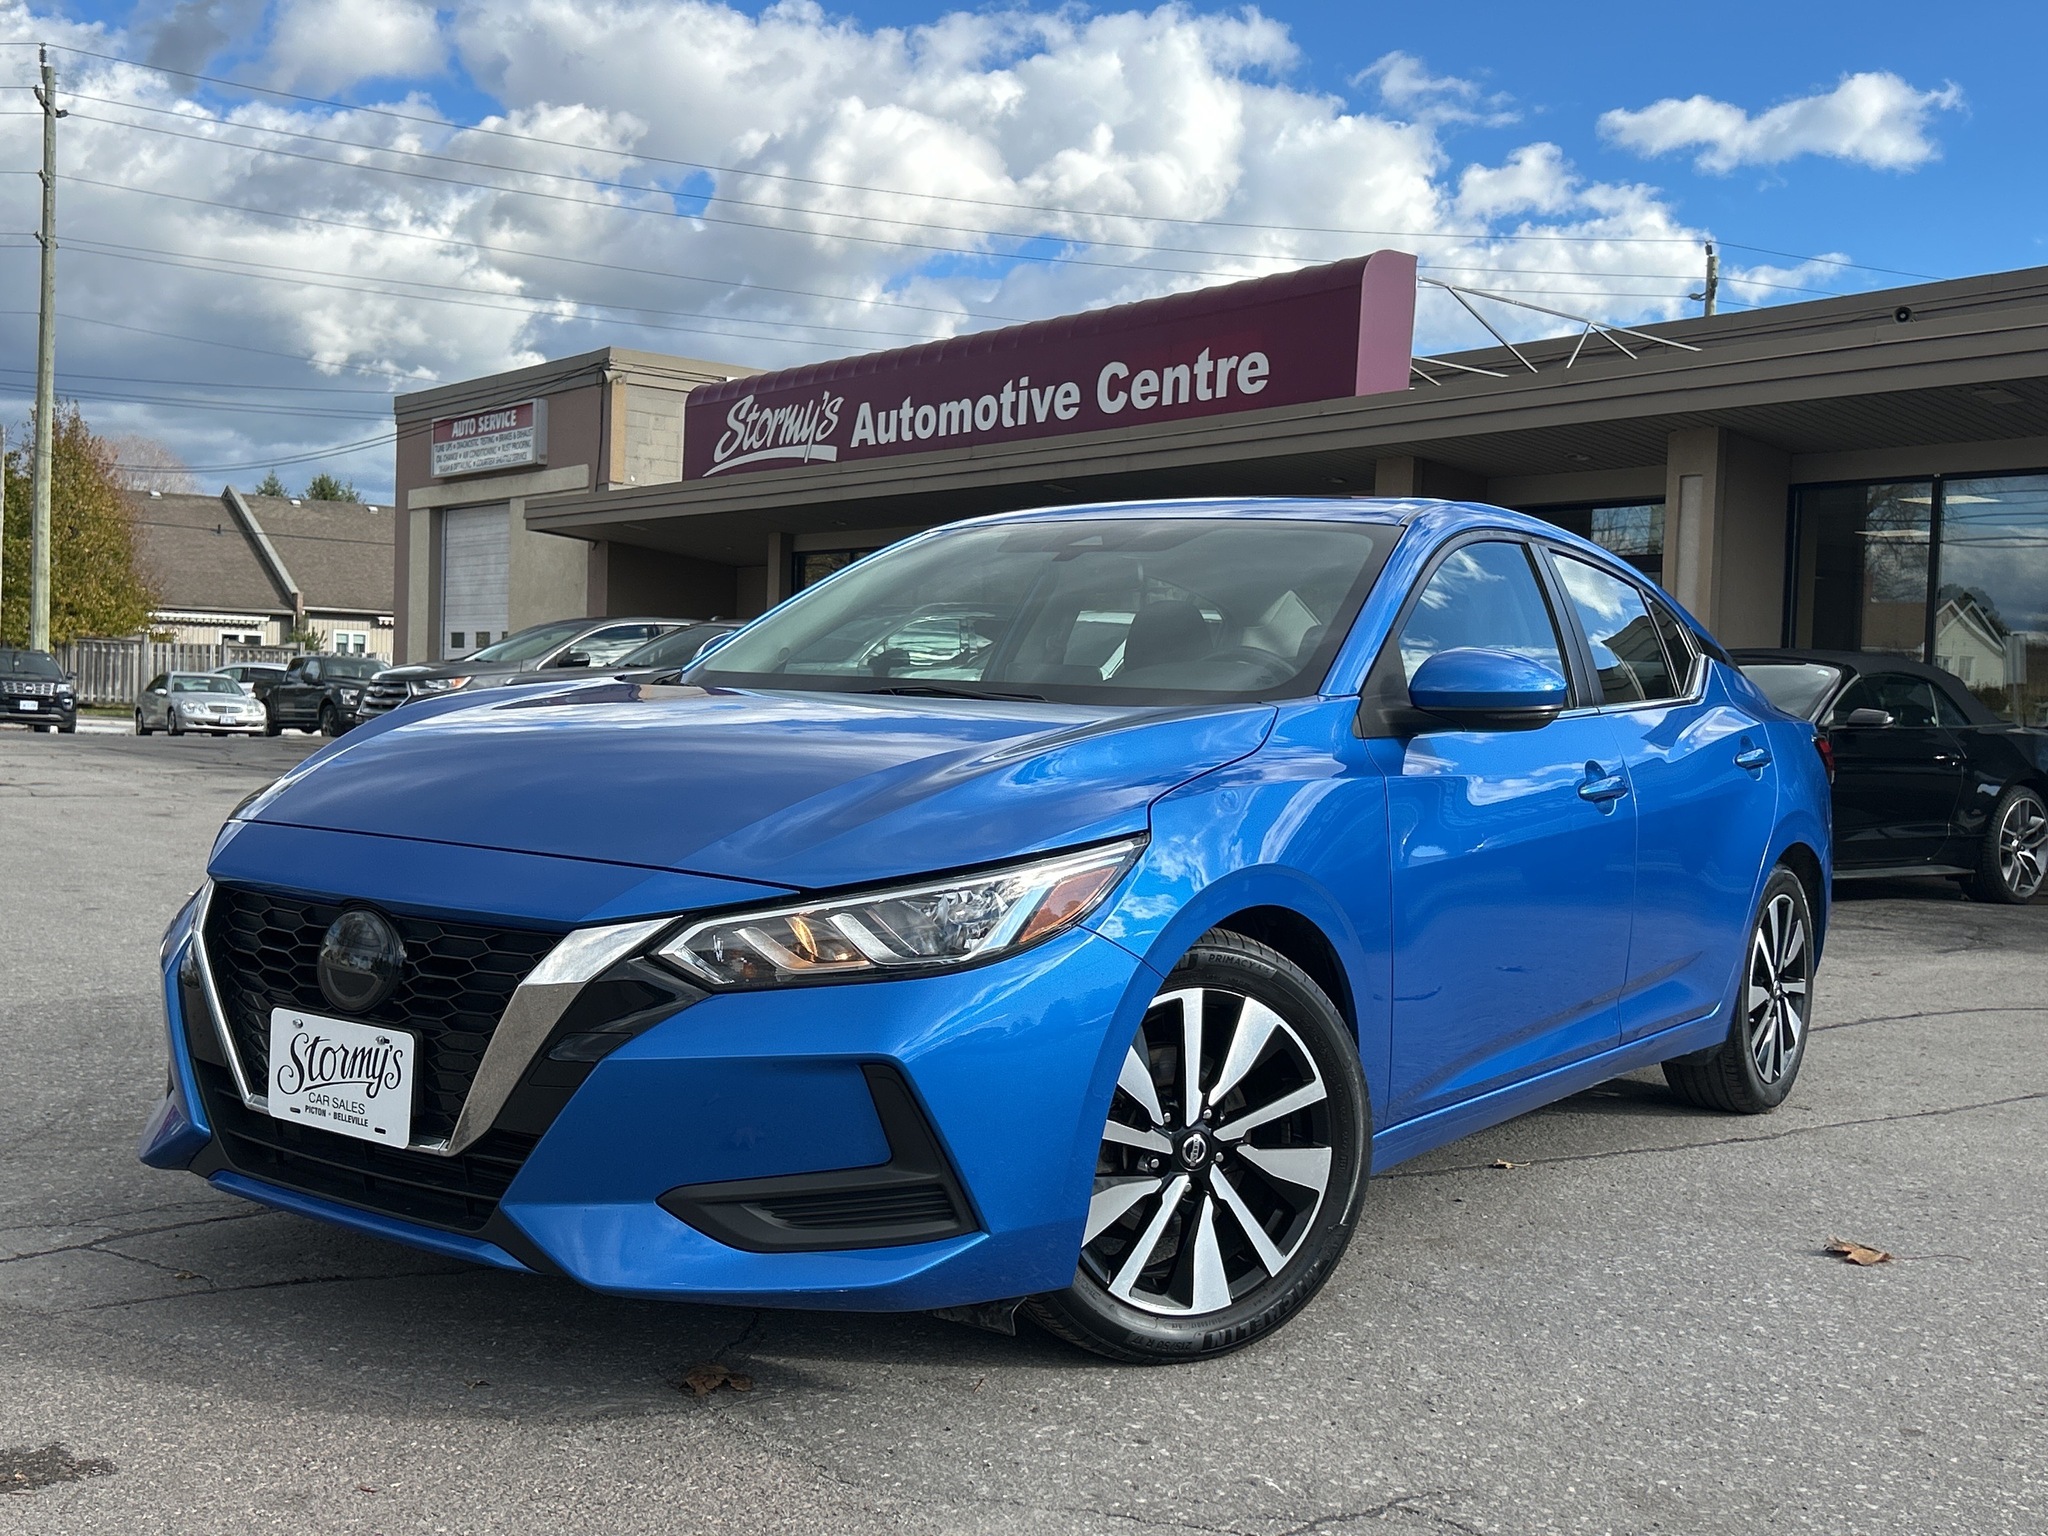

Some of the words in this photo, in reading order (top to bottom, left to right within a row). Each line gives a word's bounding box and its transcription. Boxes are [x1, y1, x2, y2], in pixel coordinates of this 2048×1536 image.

[713, 391, 844, 463] Stormy's
[850, 376, 1080, 448] Automotive
[1097, 347, 1270, 414] Centre
[452, 418, 476, 438] AUTO
[478, 410, 517, 433] SERVICE
[456, 438, 479, 449] DIAGNOSTIC
[1208, 953, 1256, 970] PRIMACY
[277, 1032, 403, 1099] Stormy's
[305, 1104, 327, 1117] PICTON
[333, 1112, 369, 1128] BELLEVILLE
[308, 1092, 330, 1107] CAR
[332, 1097, 366, 1115] SALES
[1207, 1265, 1322, 1348] MICHELIN
